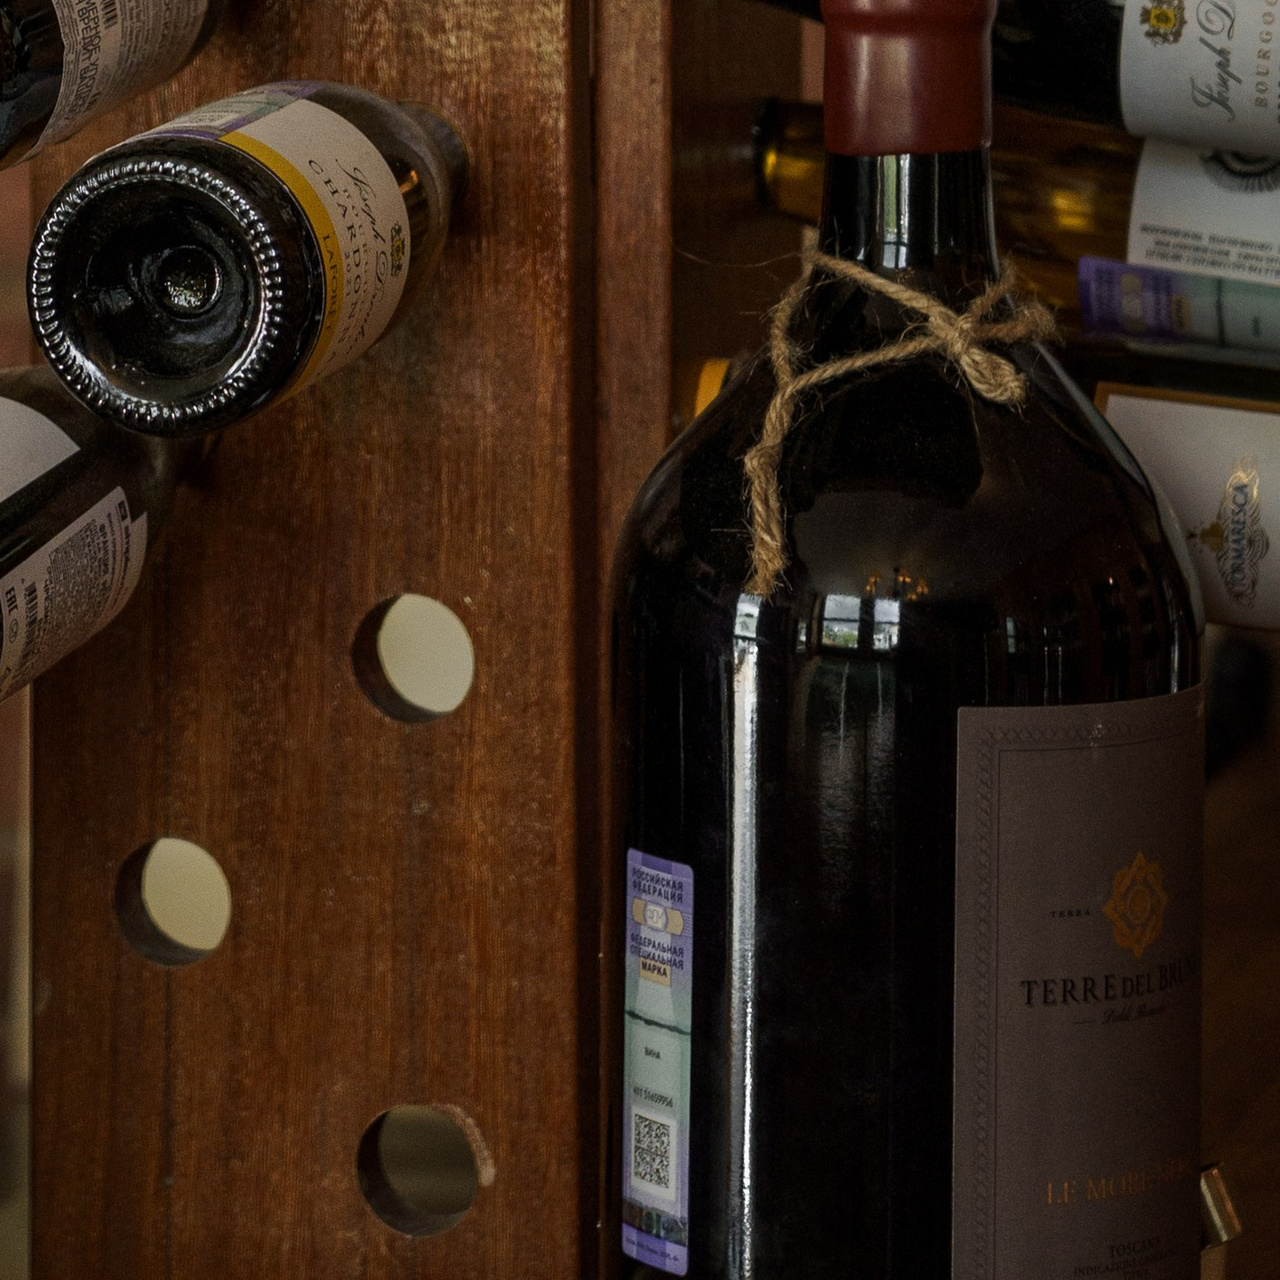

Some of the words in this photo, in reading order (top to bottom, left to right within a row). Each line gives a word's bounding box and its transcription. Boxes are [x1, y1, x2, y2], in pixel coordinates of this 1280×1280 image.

[76, 6, 94, 61] ВРЕДИТ
[1189, 36, 1242, 122] Joseph
[334, 159, 386, 243] Joseph
[632, 867, 684, 891] РОССИЙСКАЯ
[632, 880, 684, 903] ФЕДЕРАЦИЯ
[630, 932, 684, 958] ФЕДЕРАЛЬНАЯ
[641, 961, 668, 978] МАРКА
[1021, 974, 1117, 1007] TERRE
[1121, 973, 1155, 999] DEL
